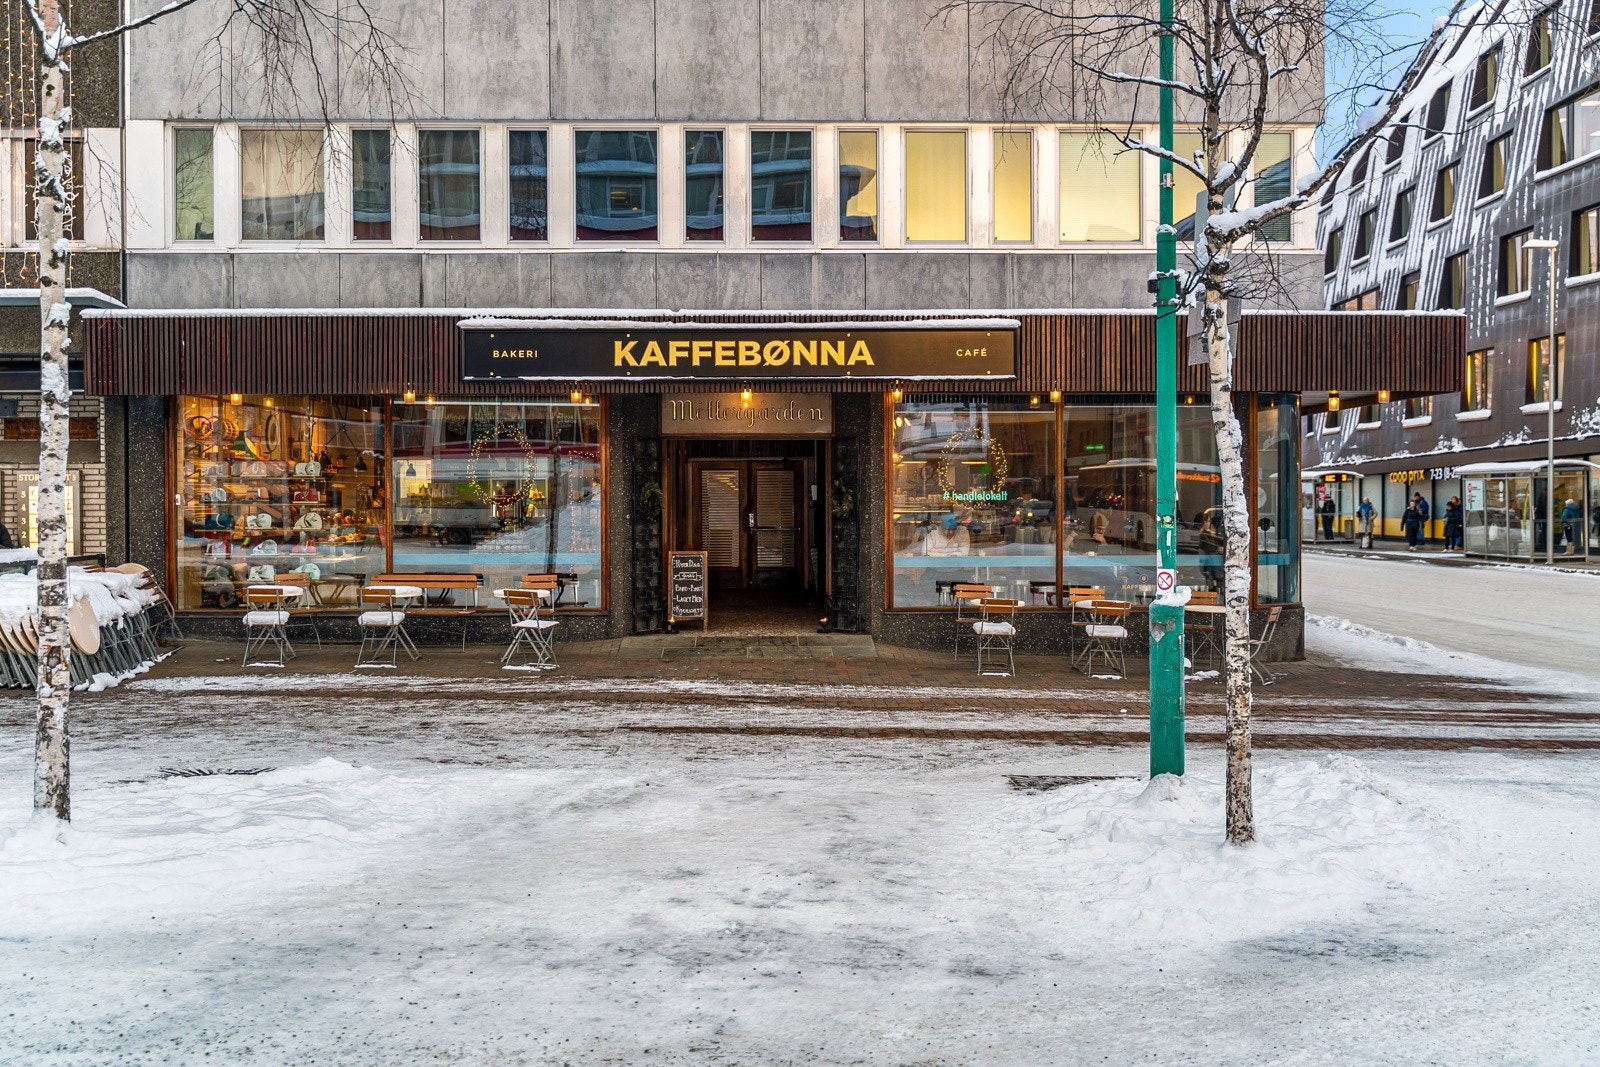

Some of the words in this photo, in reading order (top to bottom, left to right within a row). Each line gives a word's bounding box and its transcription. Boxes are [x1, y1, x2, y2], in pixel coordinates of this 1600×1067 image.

[493, 350, 538, 358] BAKERI
[614, 340, 875, 367] KAFFEBØNNA
[956, 347, 988, 357] CAFÉ
[1389, 471, 1408, 483] coop
[1408, 469, 1425, 485] prix
[1430, 467, 1443, 480] 7-23
[21, 504, 26, 512] 4
[21, 531, 27, 539] 2
